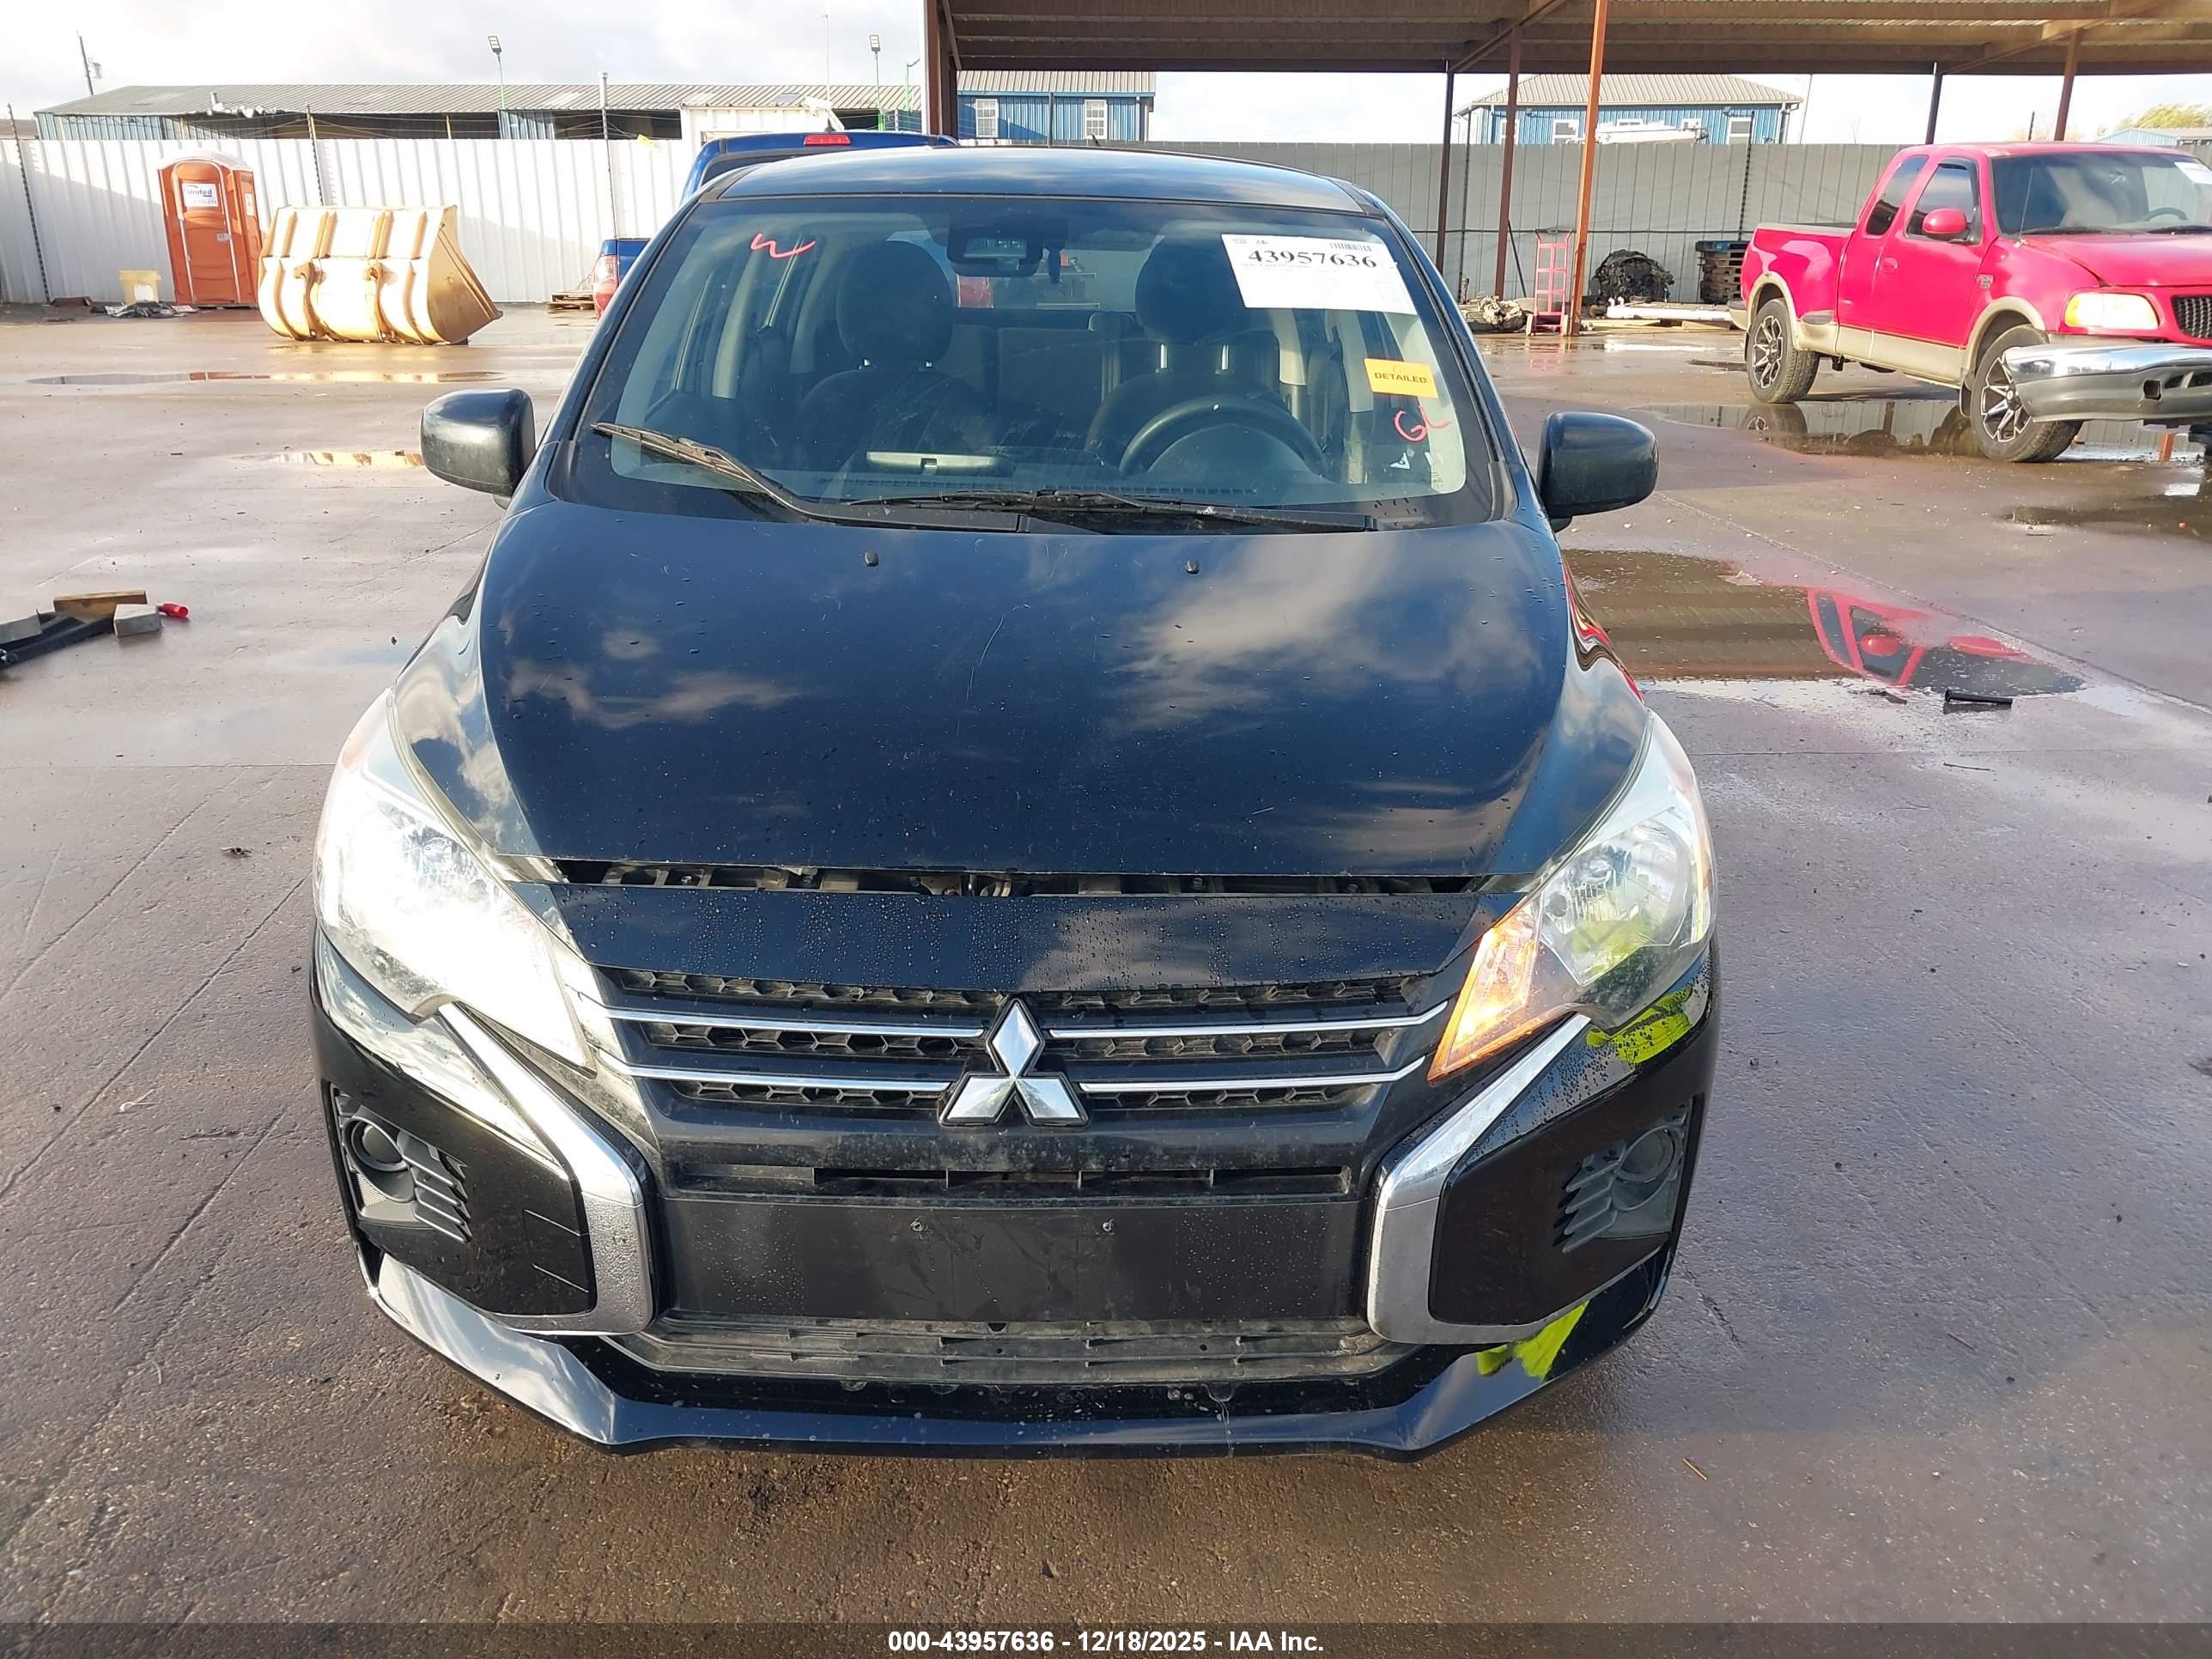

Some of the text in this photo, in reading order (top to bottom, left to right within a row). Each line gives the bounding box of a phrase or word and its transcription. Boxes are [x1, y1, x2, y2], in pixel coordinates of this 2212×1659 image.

[186, 187, 213, 196] United
[1248, 249, 1377, 268] 43957636
[1374, 372, 1427, 384] DETAILED
